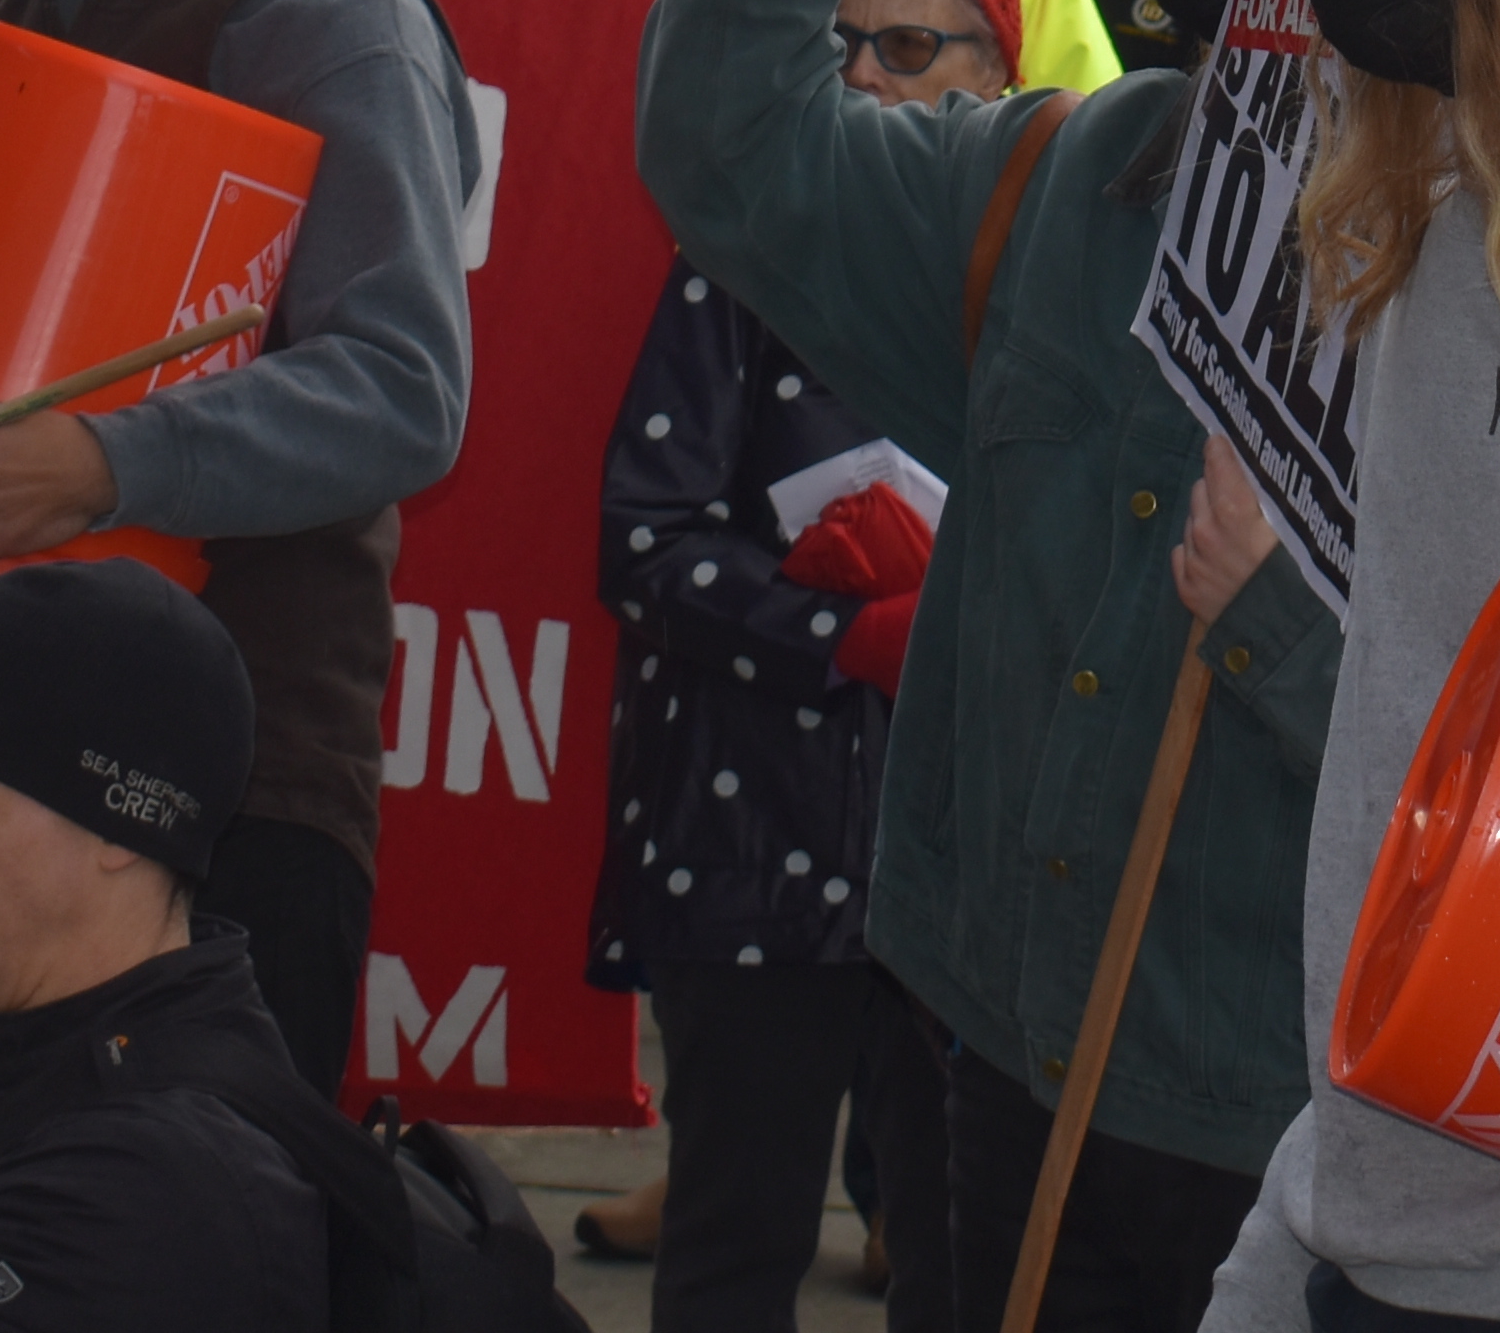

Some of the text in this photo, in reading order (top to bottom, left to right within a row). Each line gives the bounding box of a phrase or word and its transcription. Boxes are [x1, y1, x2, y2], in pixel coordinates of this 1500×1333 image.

[1154, 267, 1188, 351] Party
[1184, 316, 1208, 372] for
[1203, 342, 1263, 457] Socialism
[1259, 437, 1291, 493] and
[80, 748, 121, 780] SEA
[105, 782, 179, 831] CREW
